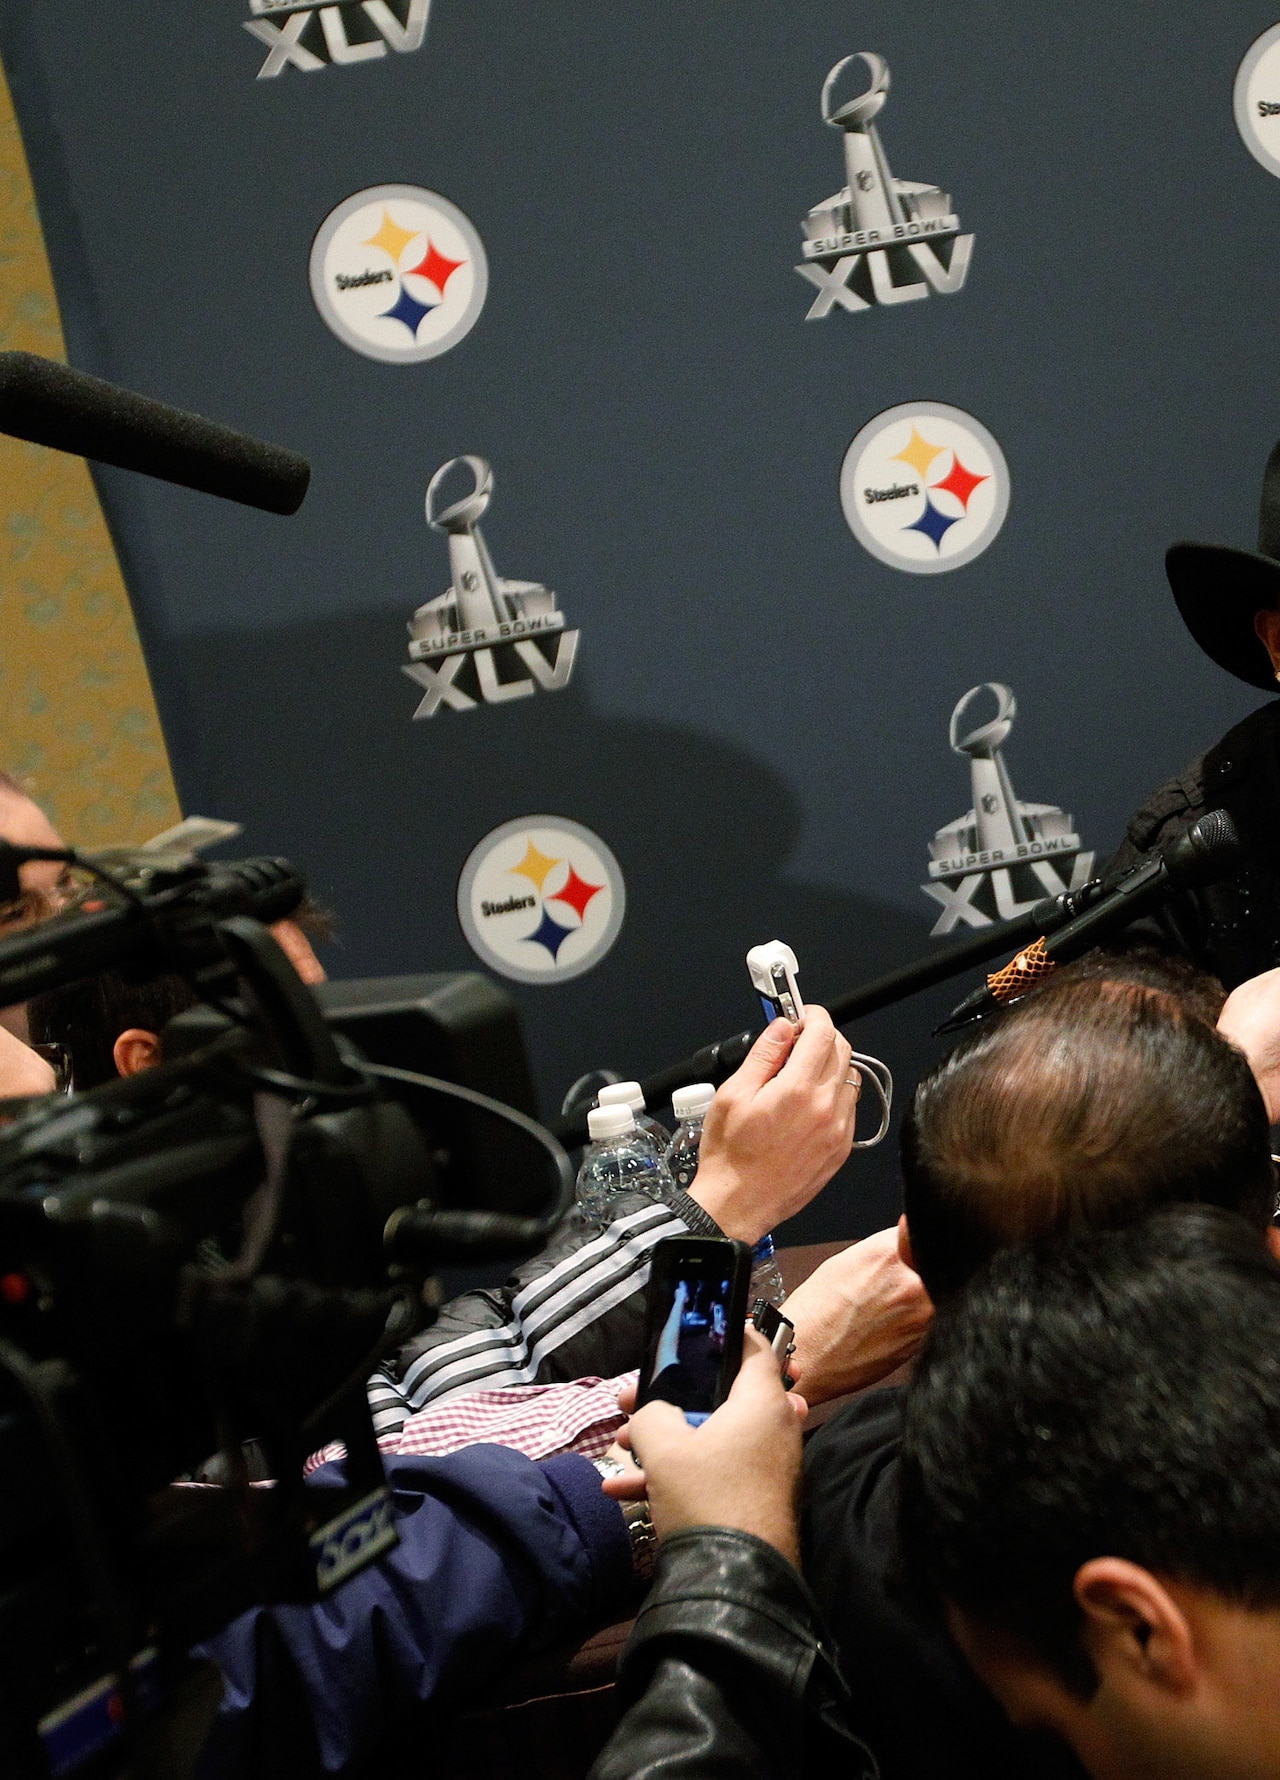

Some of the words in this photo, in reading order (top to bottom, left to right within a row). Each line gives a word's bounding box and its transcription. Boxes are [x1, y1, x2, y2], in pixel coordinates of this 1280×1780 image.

[241, 0, 432, 80] XLV
[813, 230, 880, 253] SUPER
[894, 217, 950, 239] BOWL
[794, 233, 976, 322] XLV
[863, 483, 919, 505] Steelers
[418, 629, 487, 654] SUPER
[500, 615, 556, 636] BOWL
[401, 629, 580, 721] XLV
[938, 850, 1004, 874] SUPER
[1016, 837, 1072, 858] BOWL
[481, 895, 536, 917] Steelers
[920, 851, 1095, 937] XLV
